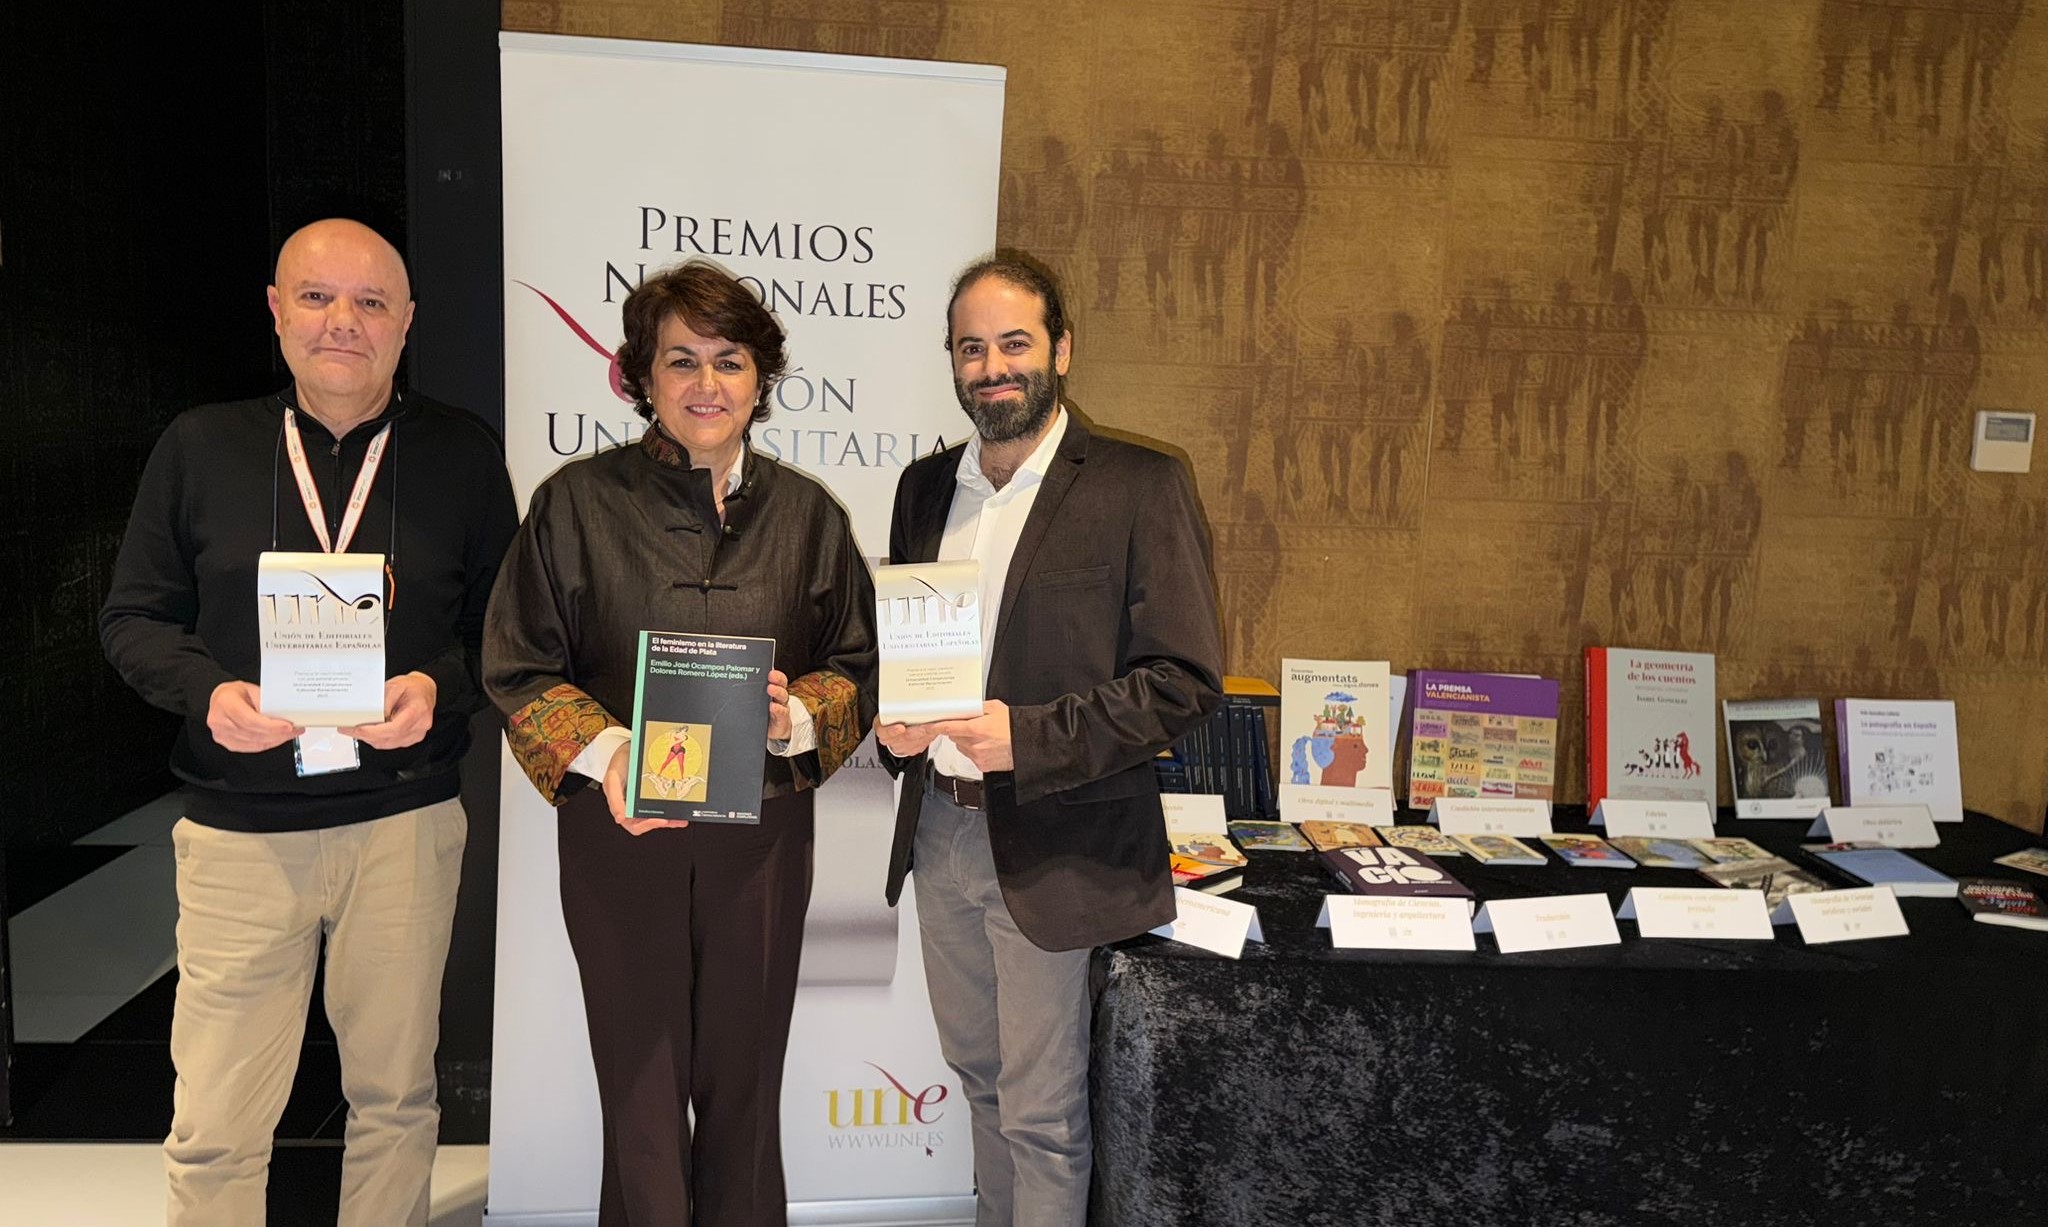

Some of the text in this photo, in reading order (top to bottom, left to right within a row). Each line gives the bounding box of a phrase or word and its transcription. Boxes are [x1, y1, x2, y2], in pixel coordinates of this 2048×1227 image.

[638, 206, 874, 264] PREMIOS
[602, 260, 907, 320] NONALES
[660, 638, 697, 647] feminismo
[715, 641, 747, 650] literatura
[698, 647, 718, 656] Plata
[650, 659, 761, 674] Emilio José Ocampos Palomar y
[1629, 659, 1641, 669] La
[649, 667, 748, 680] Dolores Romero López (eds.)
[1290, 673, 1358, 683] augmentats
[1627, 672, 1696, 685] de los cuentos
[1425, 683, 1472, 693] LA PREMSA
[1425, 691, 1491, 703] VALENCIANISTA
[1341, 847, 1421, 866] VA
[822, 1061, 948, 1129] une
